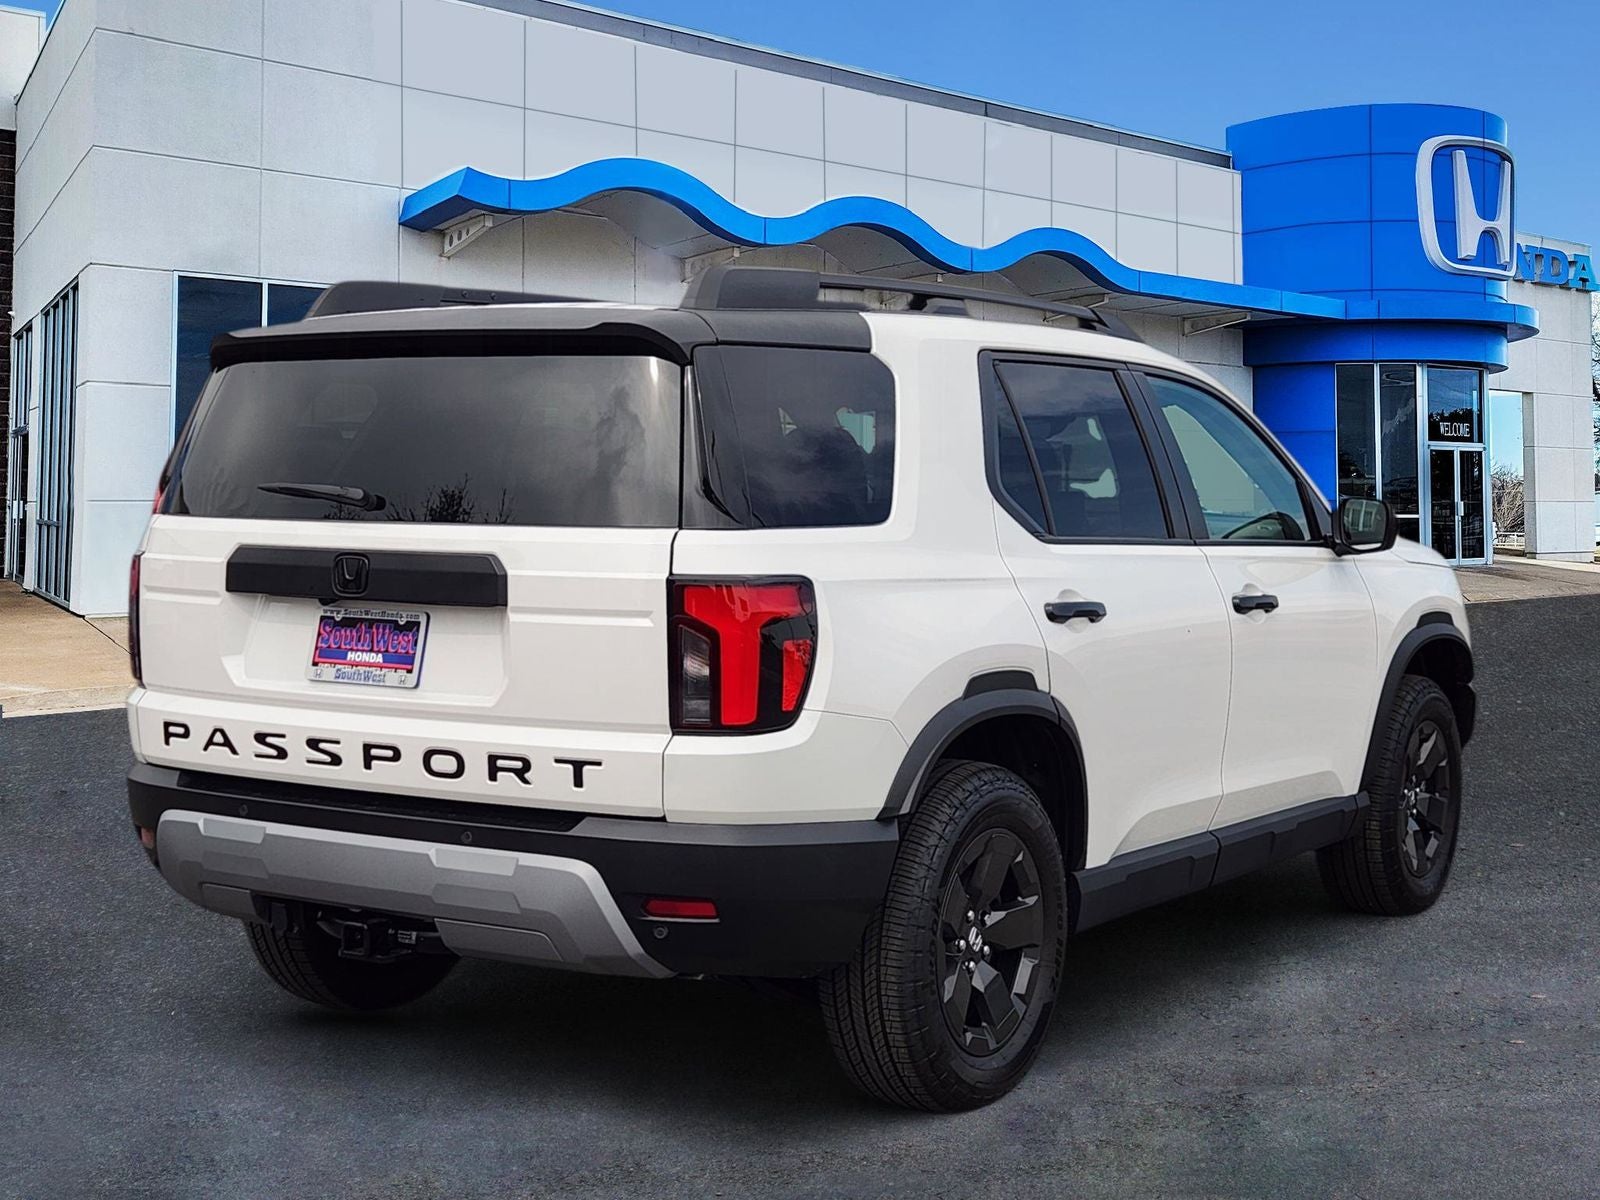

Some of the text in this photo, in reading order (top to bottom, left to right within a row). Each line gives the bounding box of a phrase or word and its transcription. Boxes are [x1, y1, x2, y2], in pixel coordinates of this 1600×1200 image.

[1514, 243, 1600, 292] NDA
[1439, 421, 1471, 438] WELCOME
[346, 651, 384, 663] HONDA
[162, 721, 603, 789] PASSPORT
